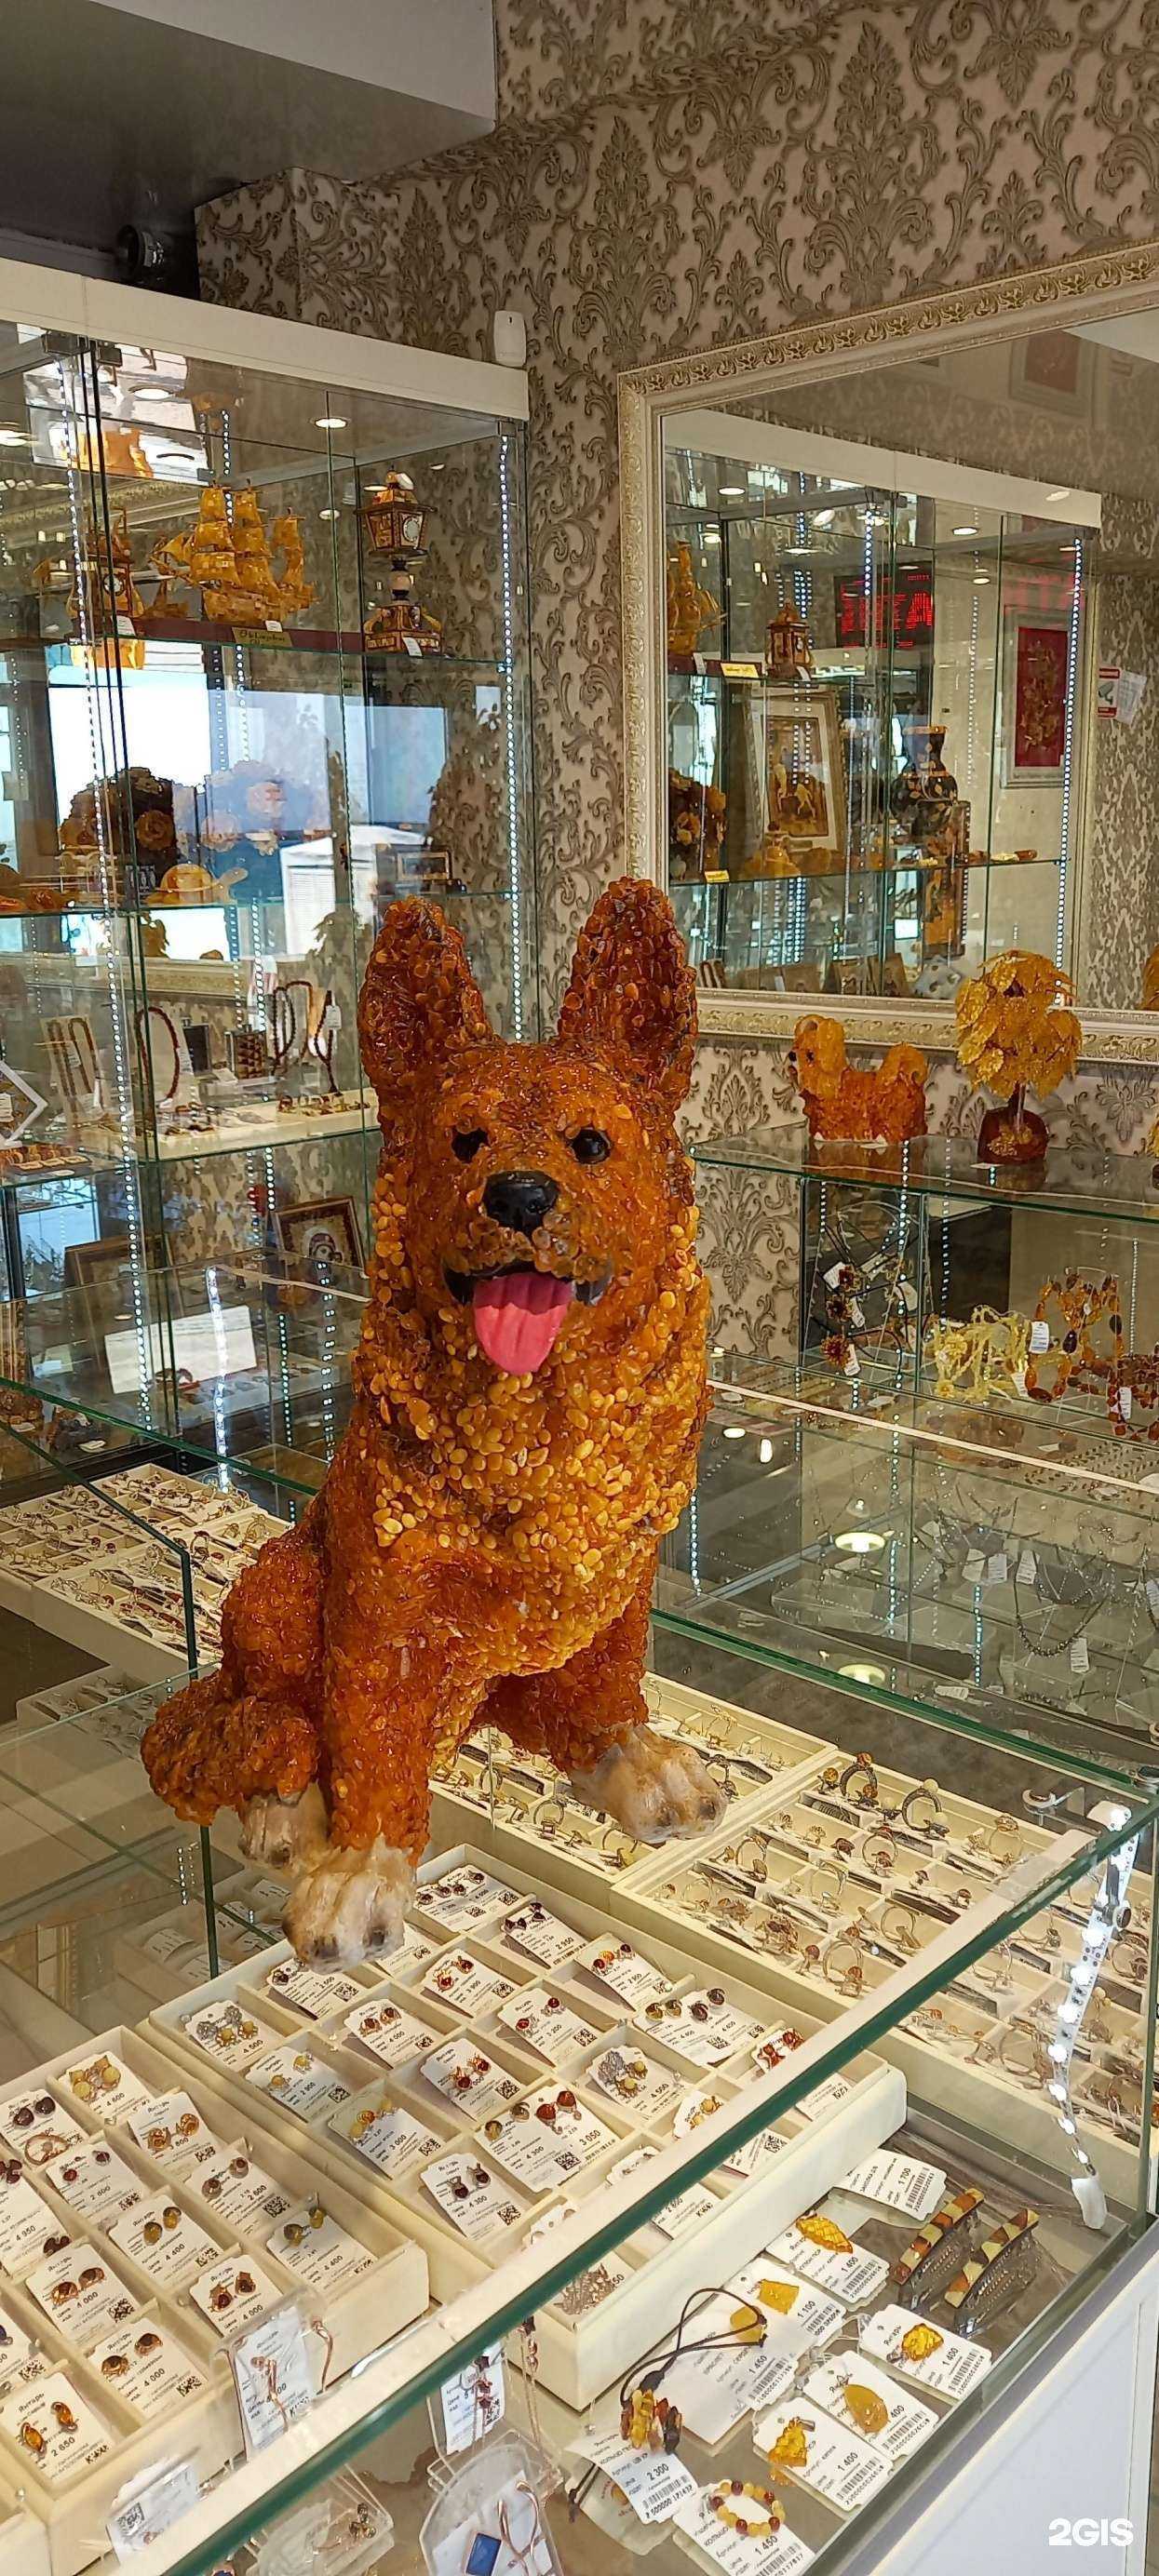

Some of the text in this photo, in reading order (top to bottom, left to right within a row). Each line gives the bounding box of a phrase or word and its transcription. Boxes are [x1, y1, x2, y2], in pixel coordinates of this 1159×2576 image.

[845, 2256, 859, 2270] 400
[82, 2291, 99, 2305] 000
[248, 2303, 264, 2317] 000
[797, 2301, 816, 2319] 1 100
[753, 2355, 769, 2370] 450
[941, 2346, 960, 2367] 1 400
[149, 2368, 166, 2382] 000
[18, 2393, 46, 2413] Янтарь
[837, 2451, 859, 2473] 1 400
[646, 2462, 670, 2482] 2 300
[754, 2535, 779, 2557] 1 450
